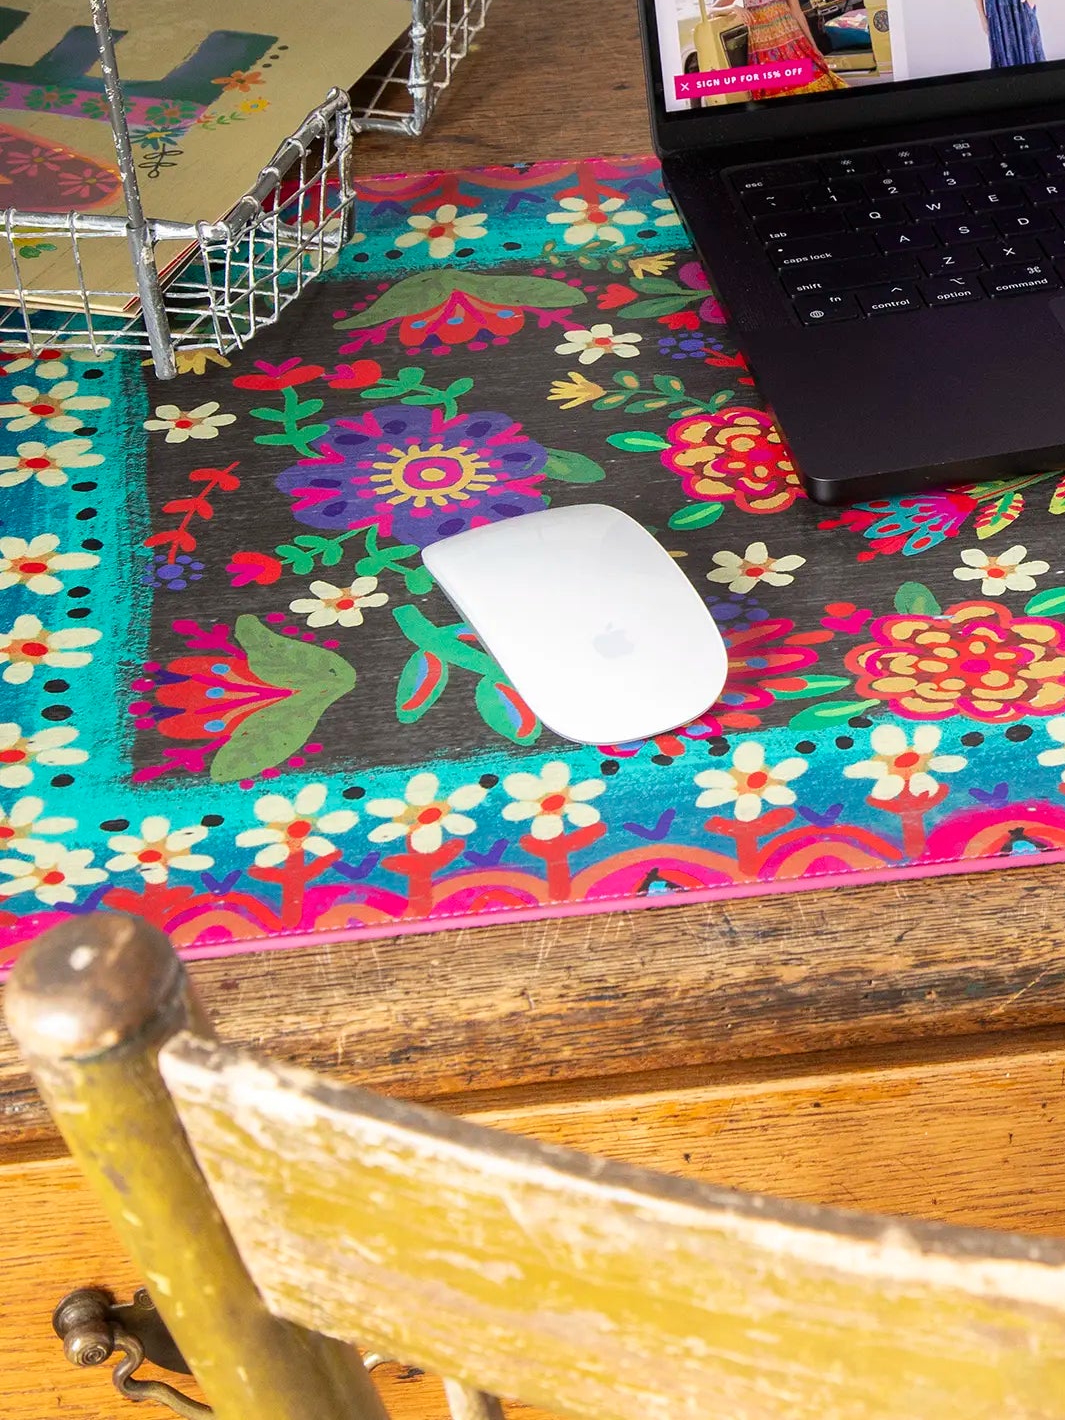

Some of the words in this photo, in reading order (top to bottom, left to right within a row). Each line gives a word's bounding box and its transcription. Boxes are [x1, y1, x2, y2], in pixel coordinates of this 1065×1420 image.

[696, 79, 720, 89] SIGN
[724, 76, 737, 84] UP
[740, 73, 760, 82] FOR
[763, 70, 781, 80] 15%
[785, 68, 803, 76] OFF
[745, 181, 763, 189] esc
[770, 231, 787, 239] tab
[783, 256, 808, 265] caps
[810, 252, 832, 261] lock
[797, 282, 822, 292] shift
[996, 278, 1048, 292] command
[829, 295, 842, 303] fn
[937, 289, 972, 300] option
[872, 299, 910, 310] control
